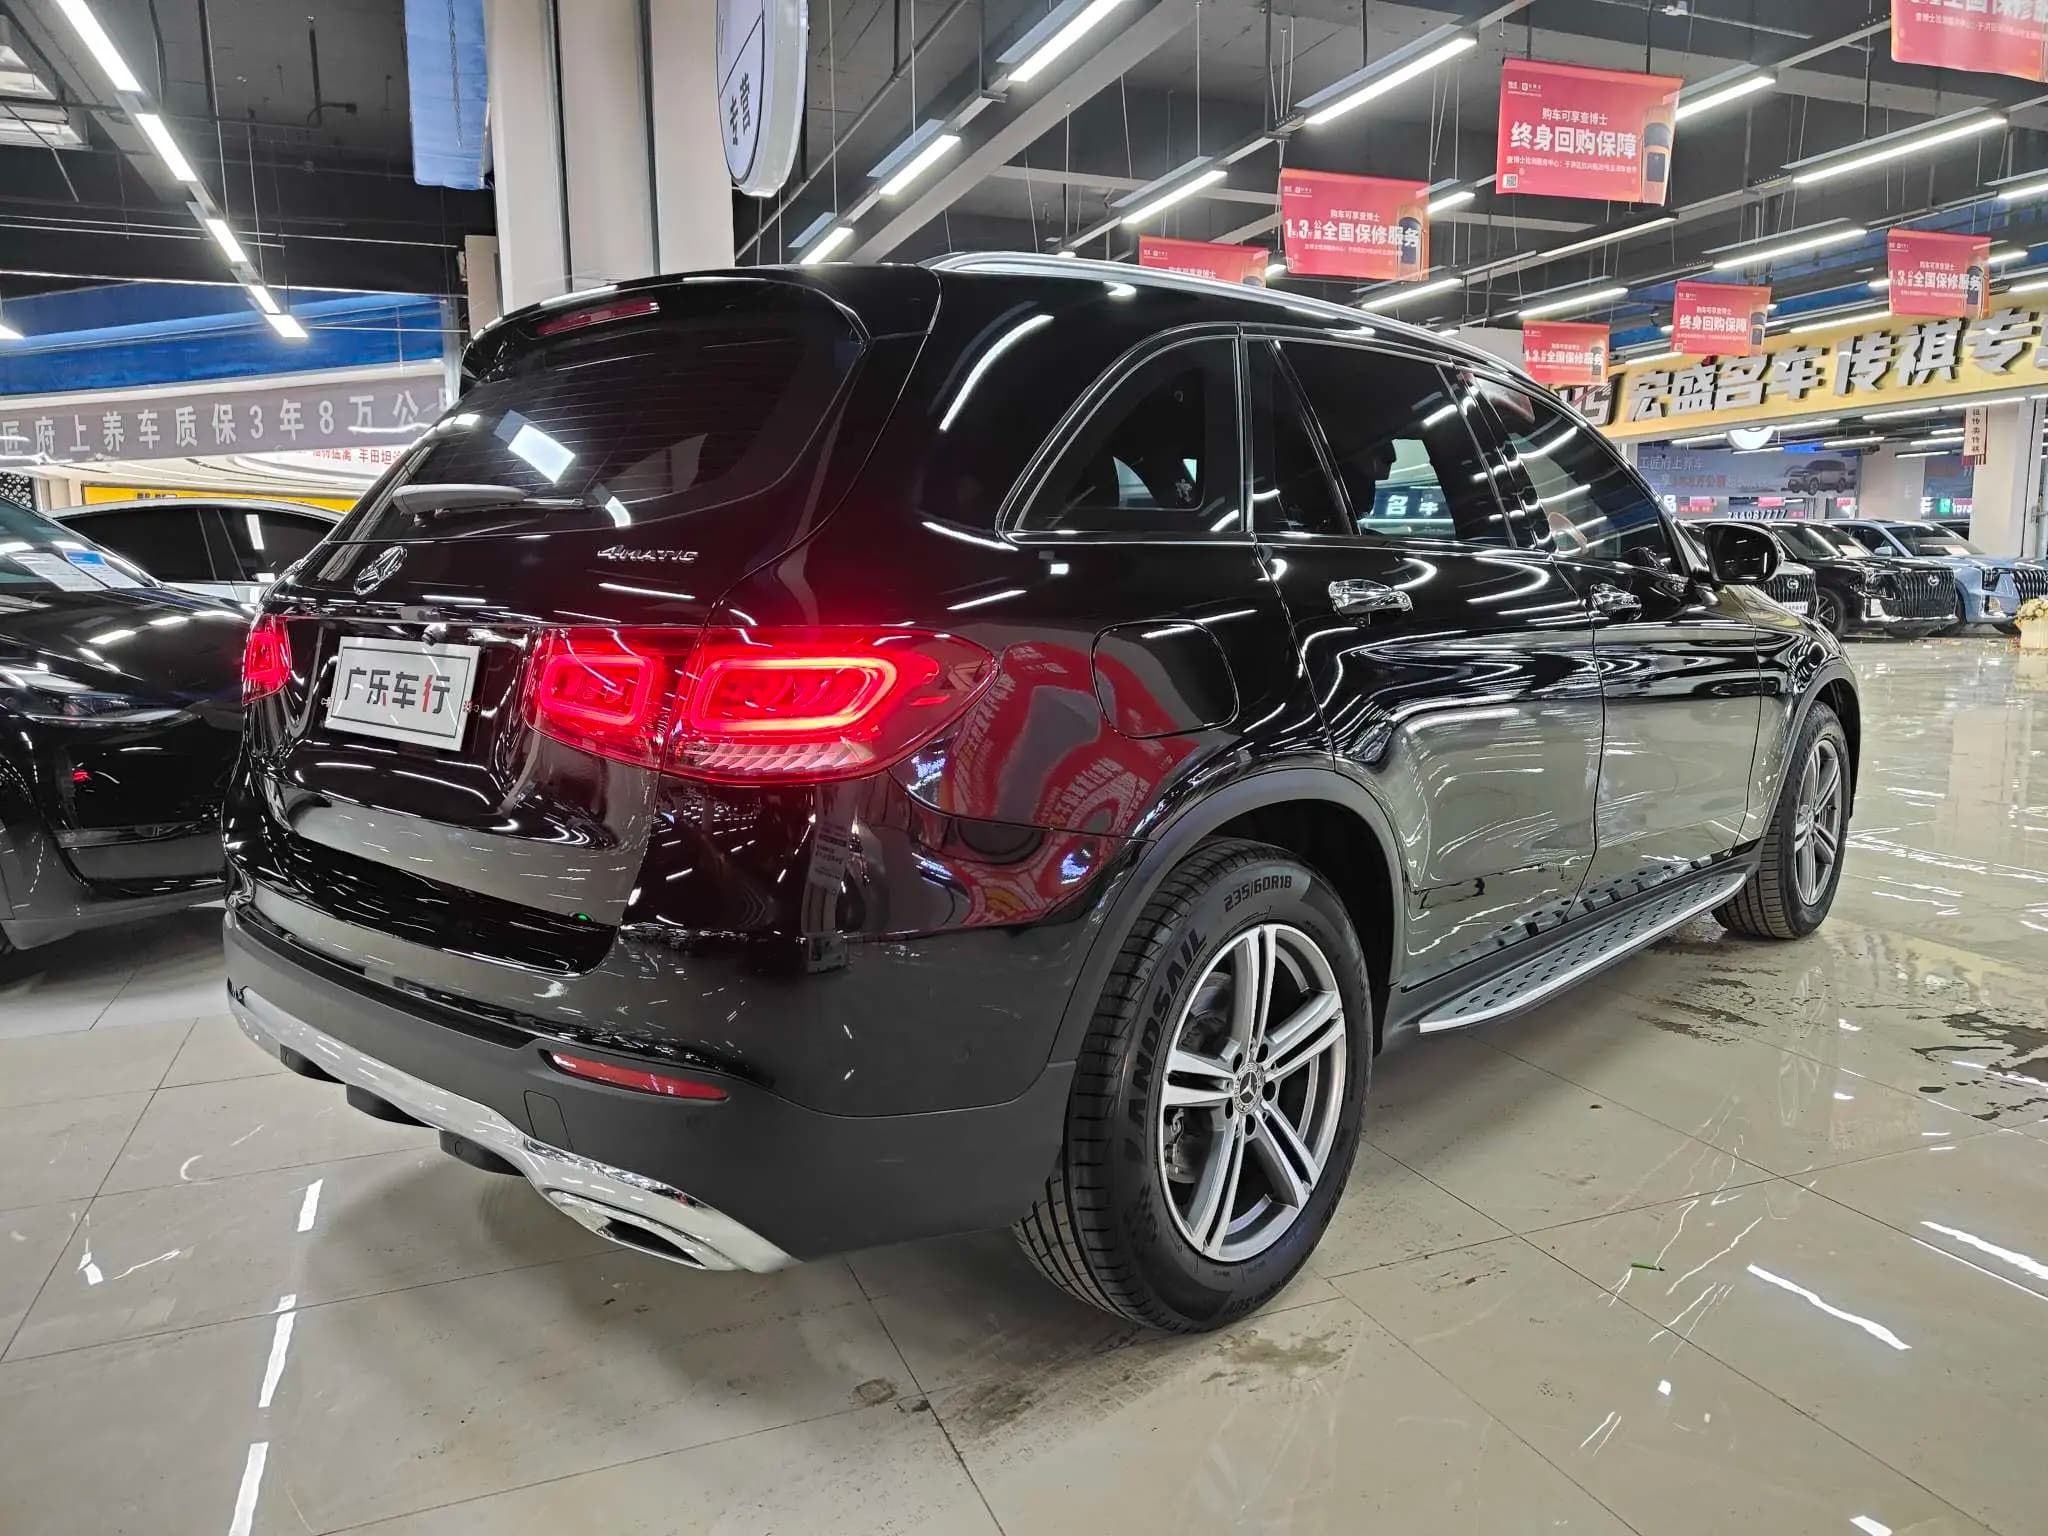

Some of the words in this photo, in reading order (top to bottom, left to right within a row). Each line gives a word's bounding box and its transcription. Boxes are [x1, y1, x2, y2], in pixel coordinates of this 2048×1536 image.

[1542, 108, 1608, 126] 购车可享查博士
[1510, 121, 1637, 160] 终身回购保障
[1679, 314, 1747, 333] 终身回购保障
[1632, 347, 1829, 421] 宏盛名车
[597, 544, 699, 561] 4MATIC
[344, 667, 451, 715] 广乐车行
[1224, 875, 1292, 912] 235/60R18
